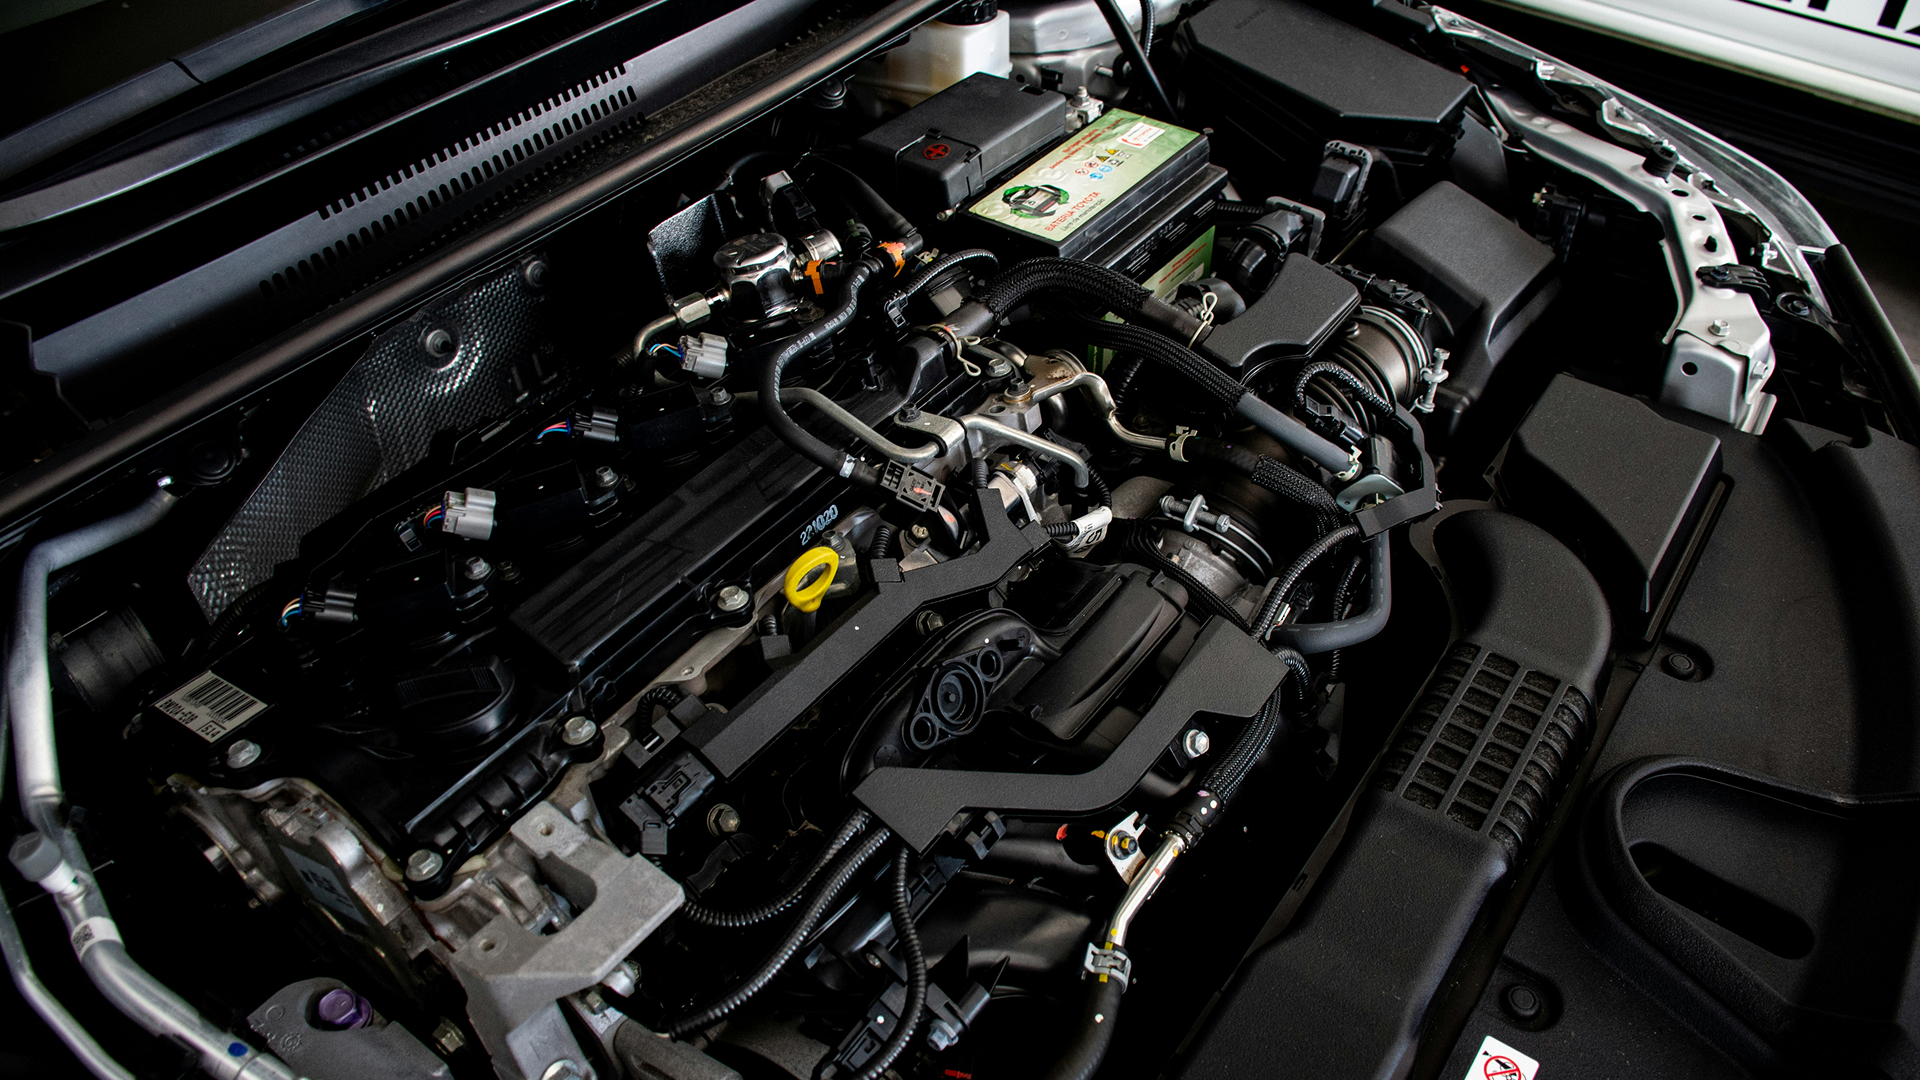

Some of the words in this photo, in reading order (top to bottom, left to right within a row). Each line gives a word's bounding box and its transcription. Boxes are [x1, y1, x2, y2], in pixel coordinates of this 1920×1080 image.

[1044, 210, 1075, 232] BATERIA
[1071, 191, 1101, 211] TOYOTA
[800, 504, 839, 546] 221020
[202, 725, 221, 738] 514
